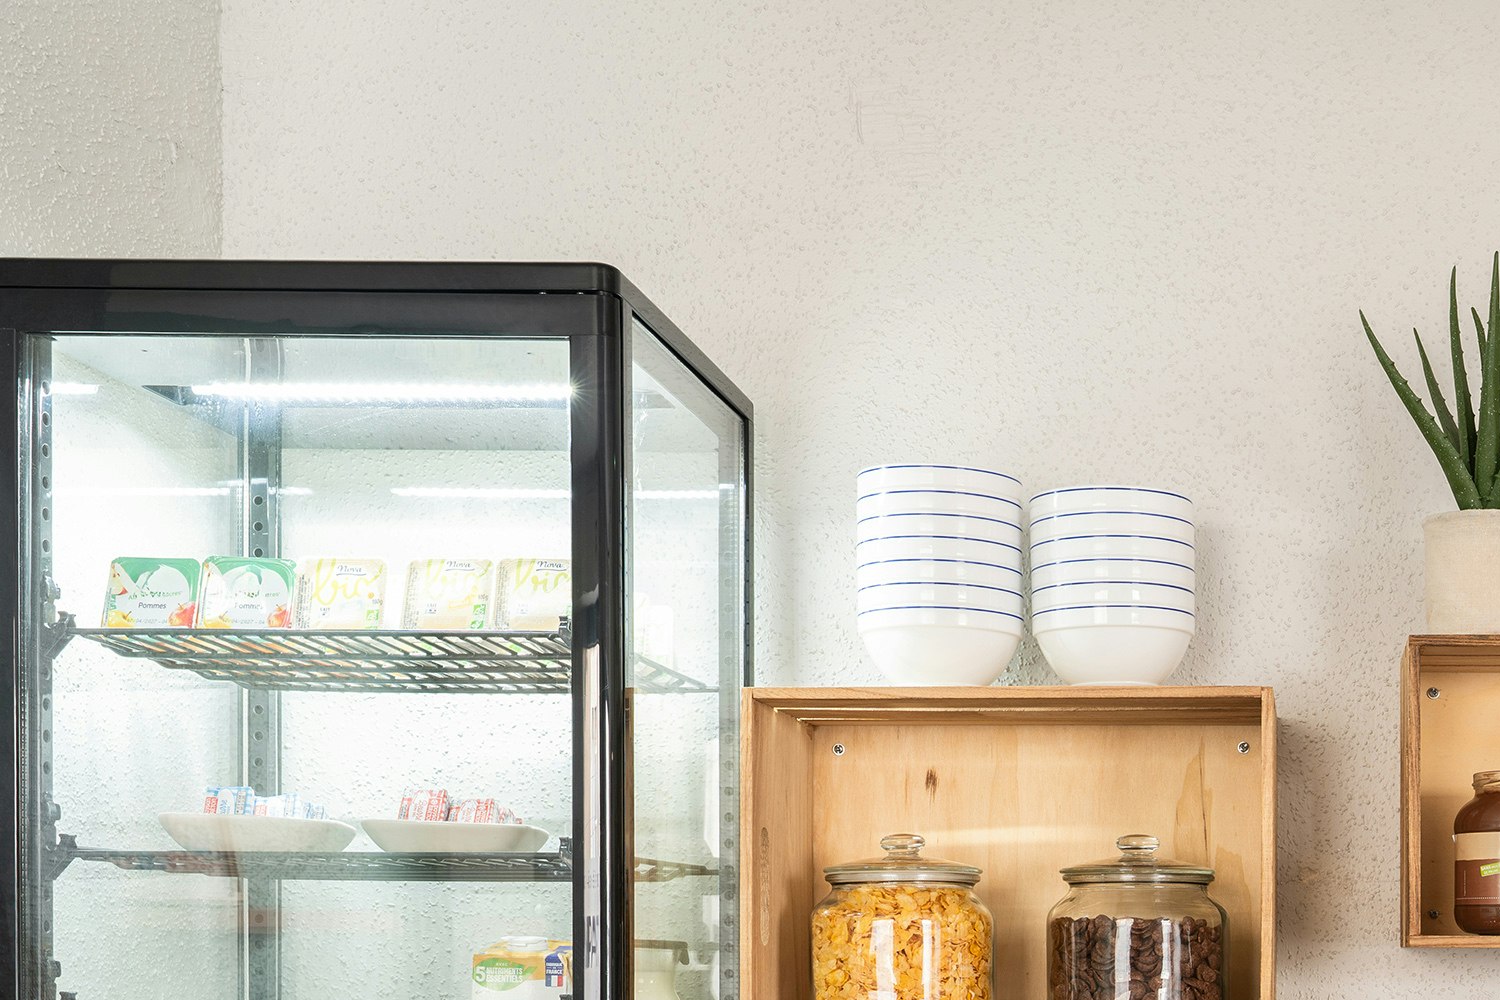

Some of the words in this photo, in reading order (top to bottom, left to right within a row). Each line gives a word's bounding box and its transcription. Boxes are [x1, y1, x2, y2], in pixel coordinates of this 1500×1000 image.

[446, 560, 471, 568] Nova
[536, 560, 563, 568] Nova
[475, 966, 486, 983] 5
